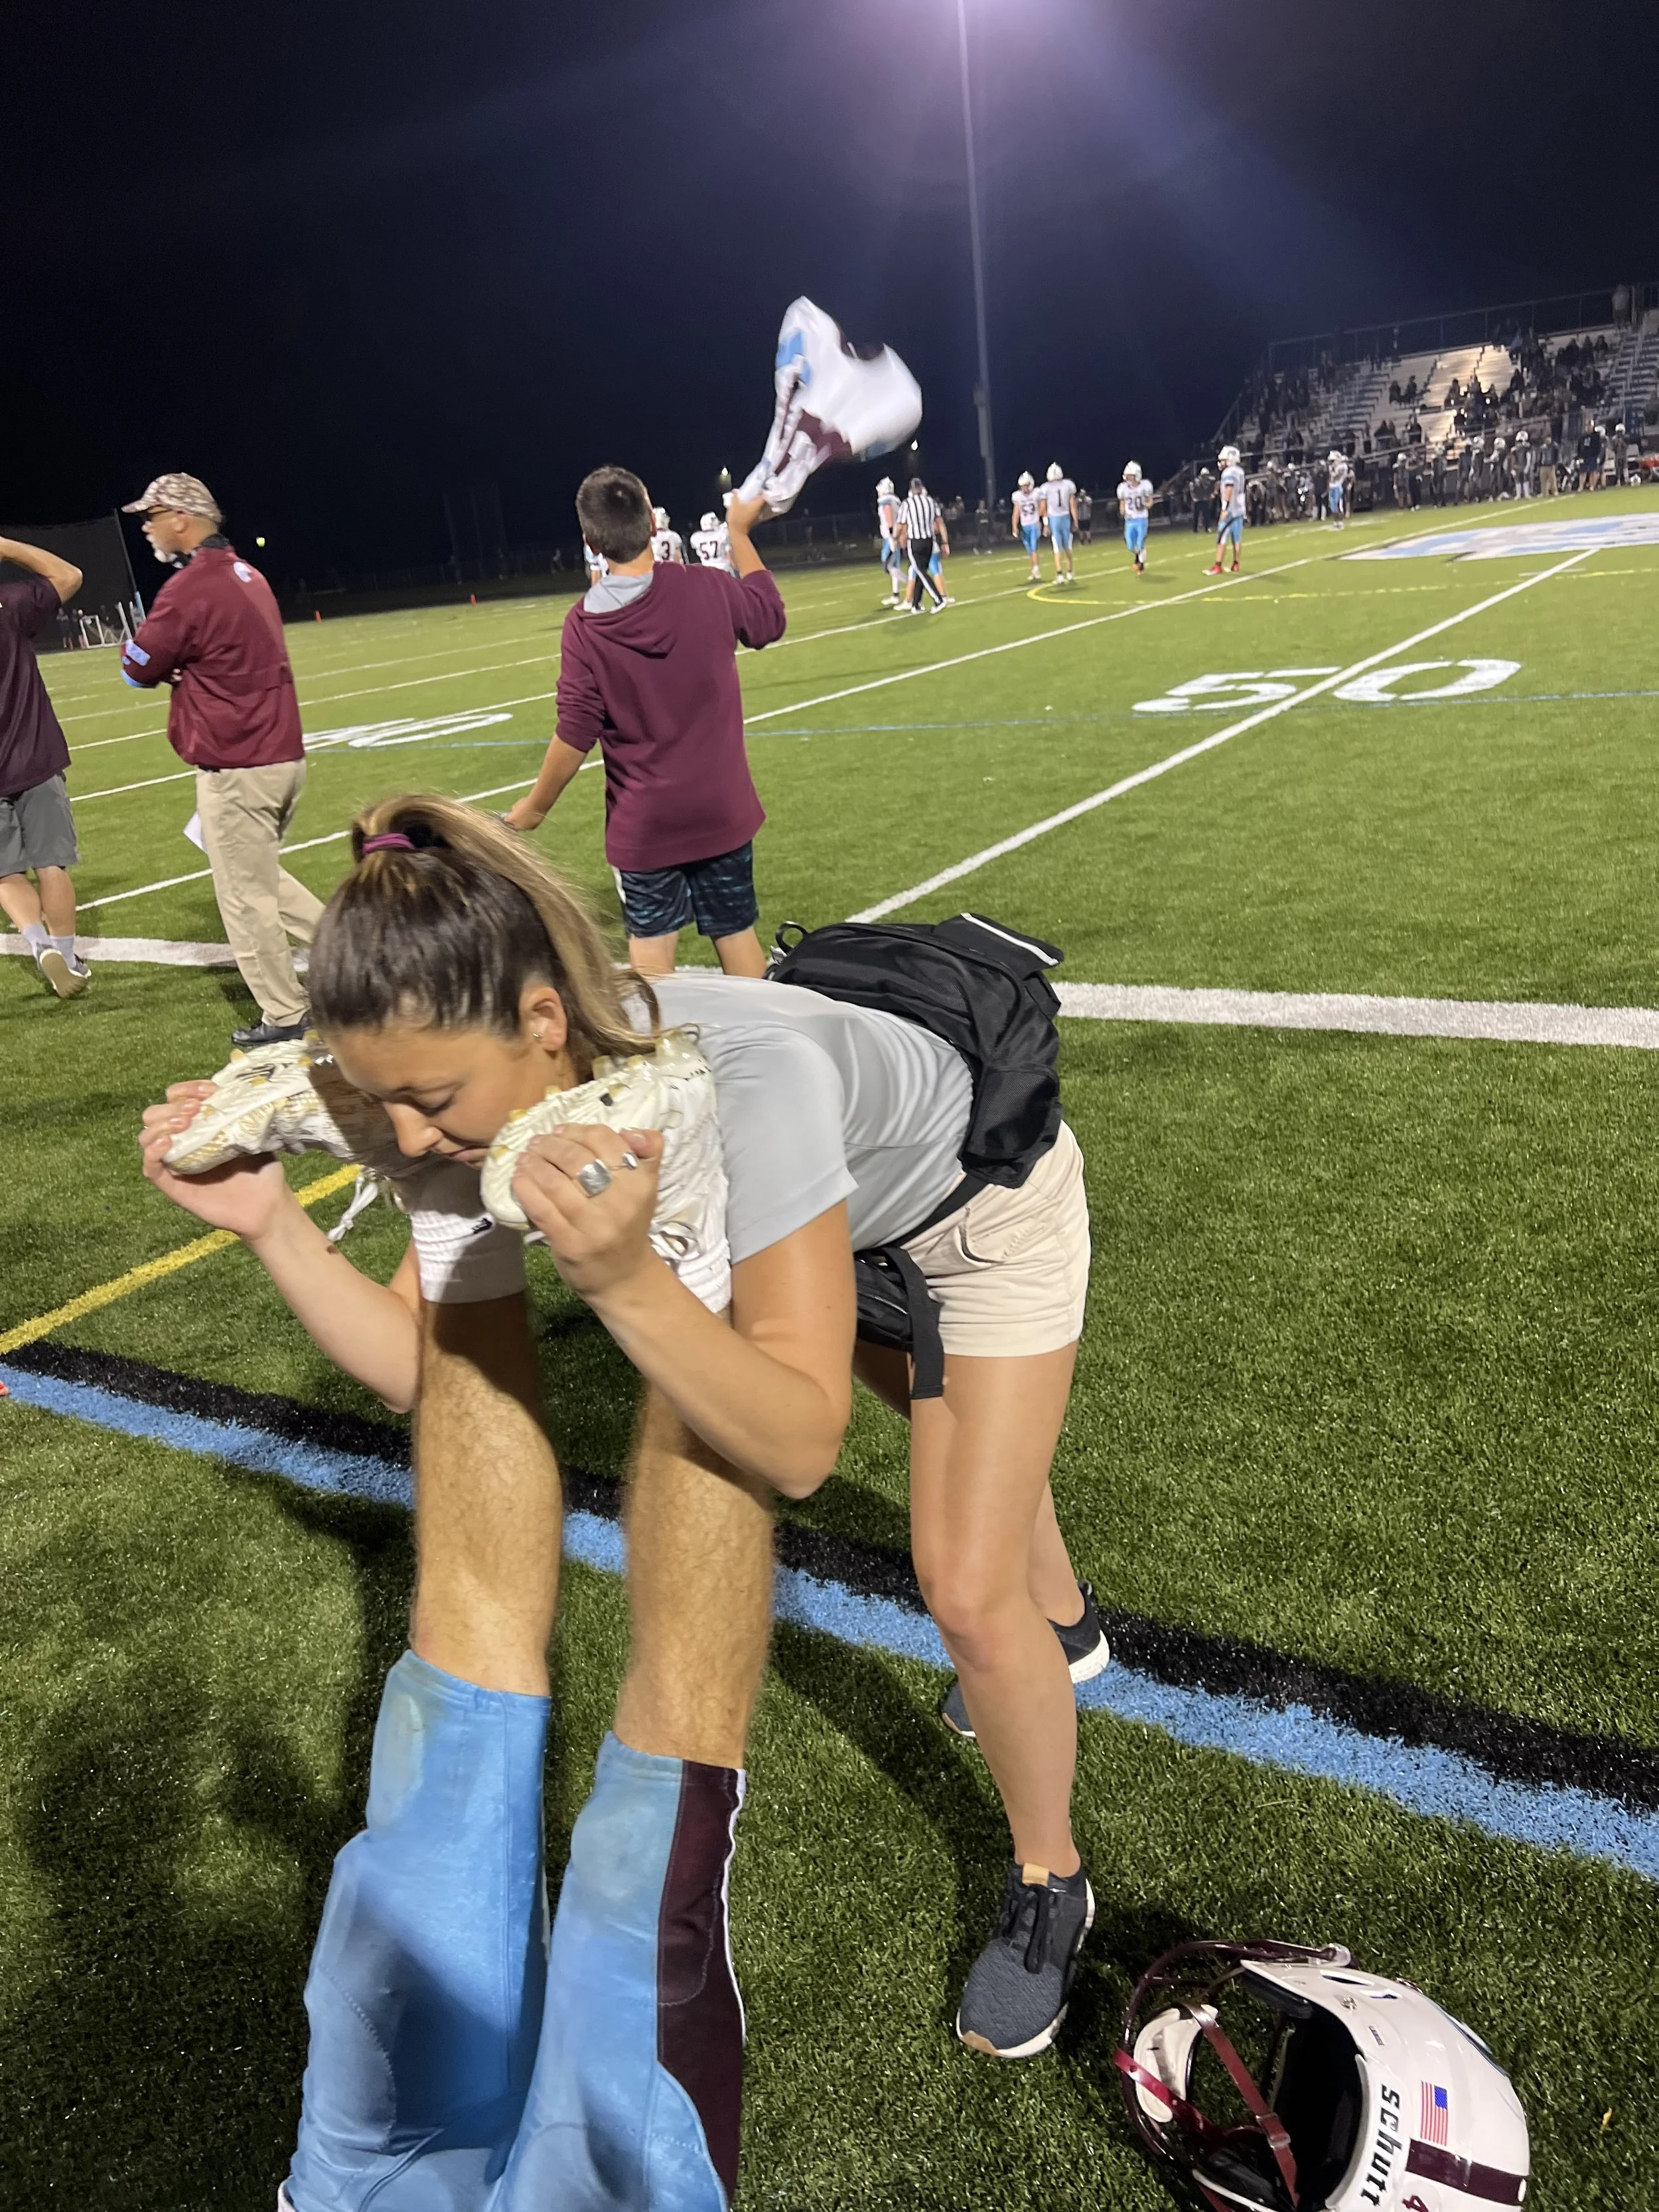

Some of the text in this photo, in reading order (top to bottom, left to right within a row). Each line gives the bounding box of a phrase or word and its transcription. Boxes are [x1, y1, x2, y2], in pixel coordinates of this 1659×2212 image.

[1126, 496, 1145, 511] 20
[700, 541, 718, 560] 57
[1131, 658, 1521, 712] 50
